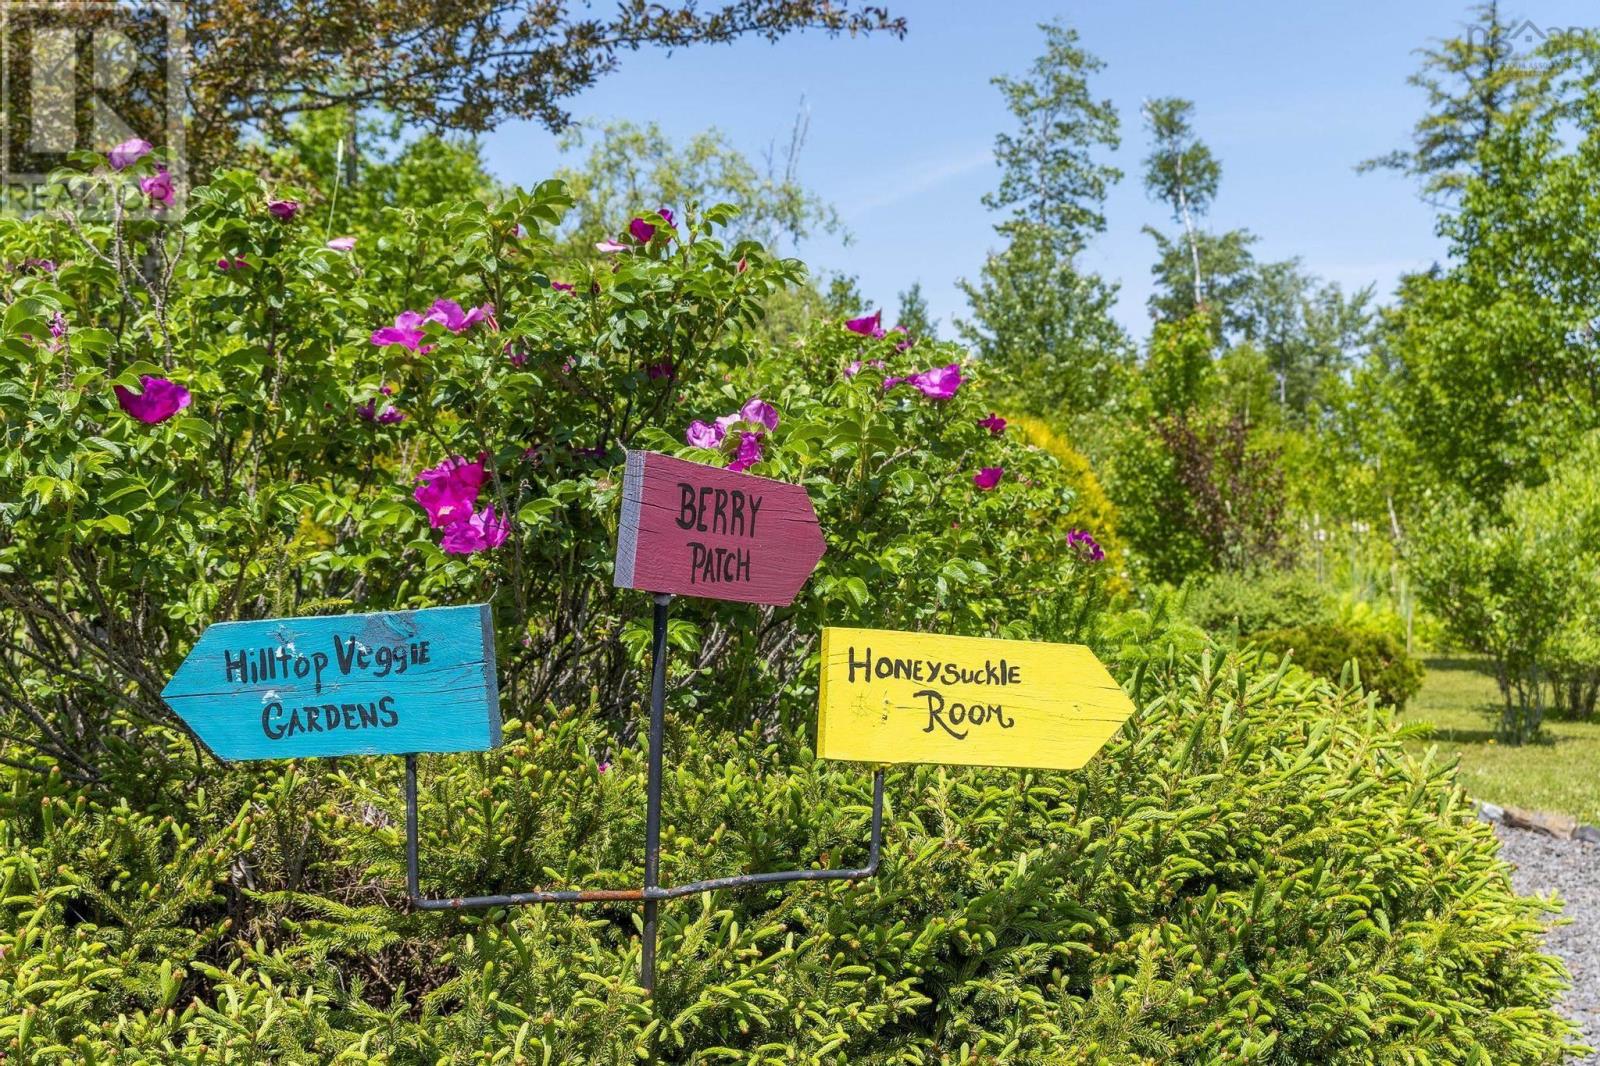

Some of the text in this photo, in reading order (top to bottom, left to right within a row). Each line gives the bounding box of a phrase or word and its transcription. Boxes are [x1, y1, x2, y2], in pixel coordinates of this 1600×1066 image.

[675, 482, 762, 538] BERRY
[687, 542, 751, 584] PATCH
[224, 647, 329, 694] Hilltop
[261, 695, 399, 741] GARDENS
